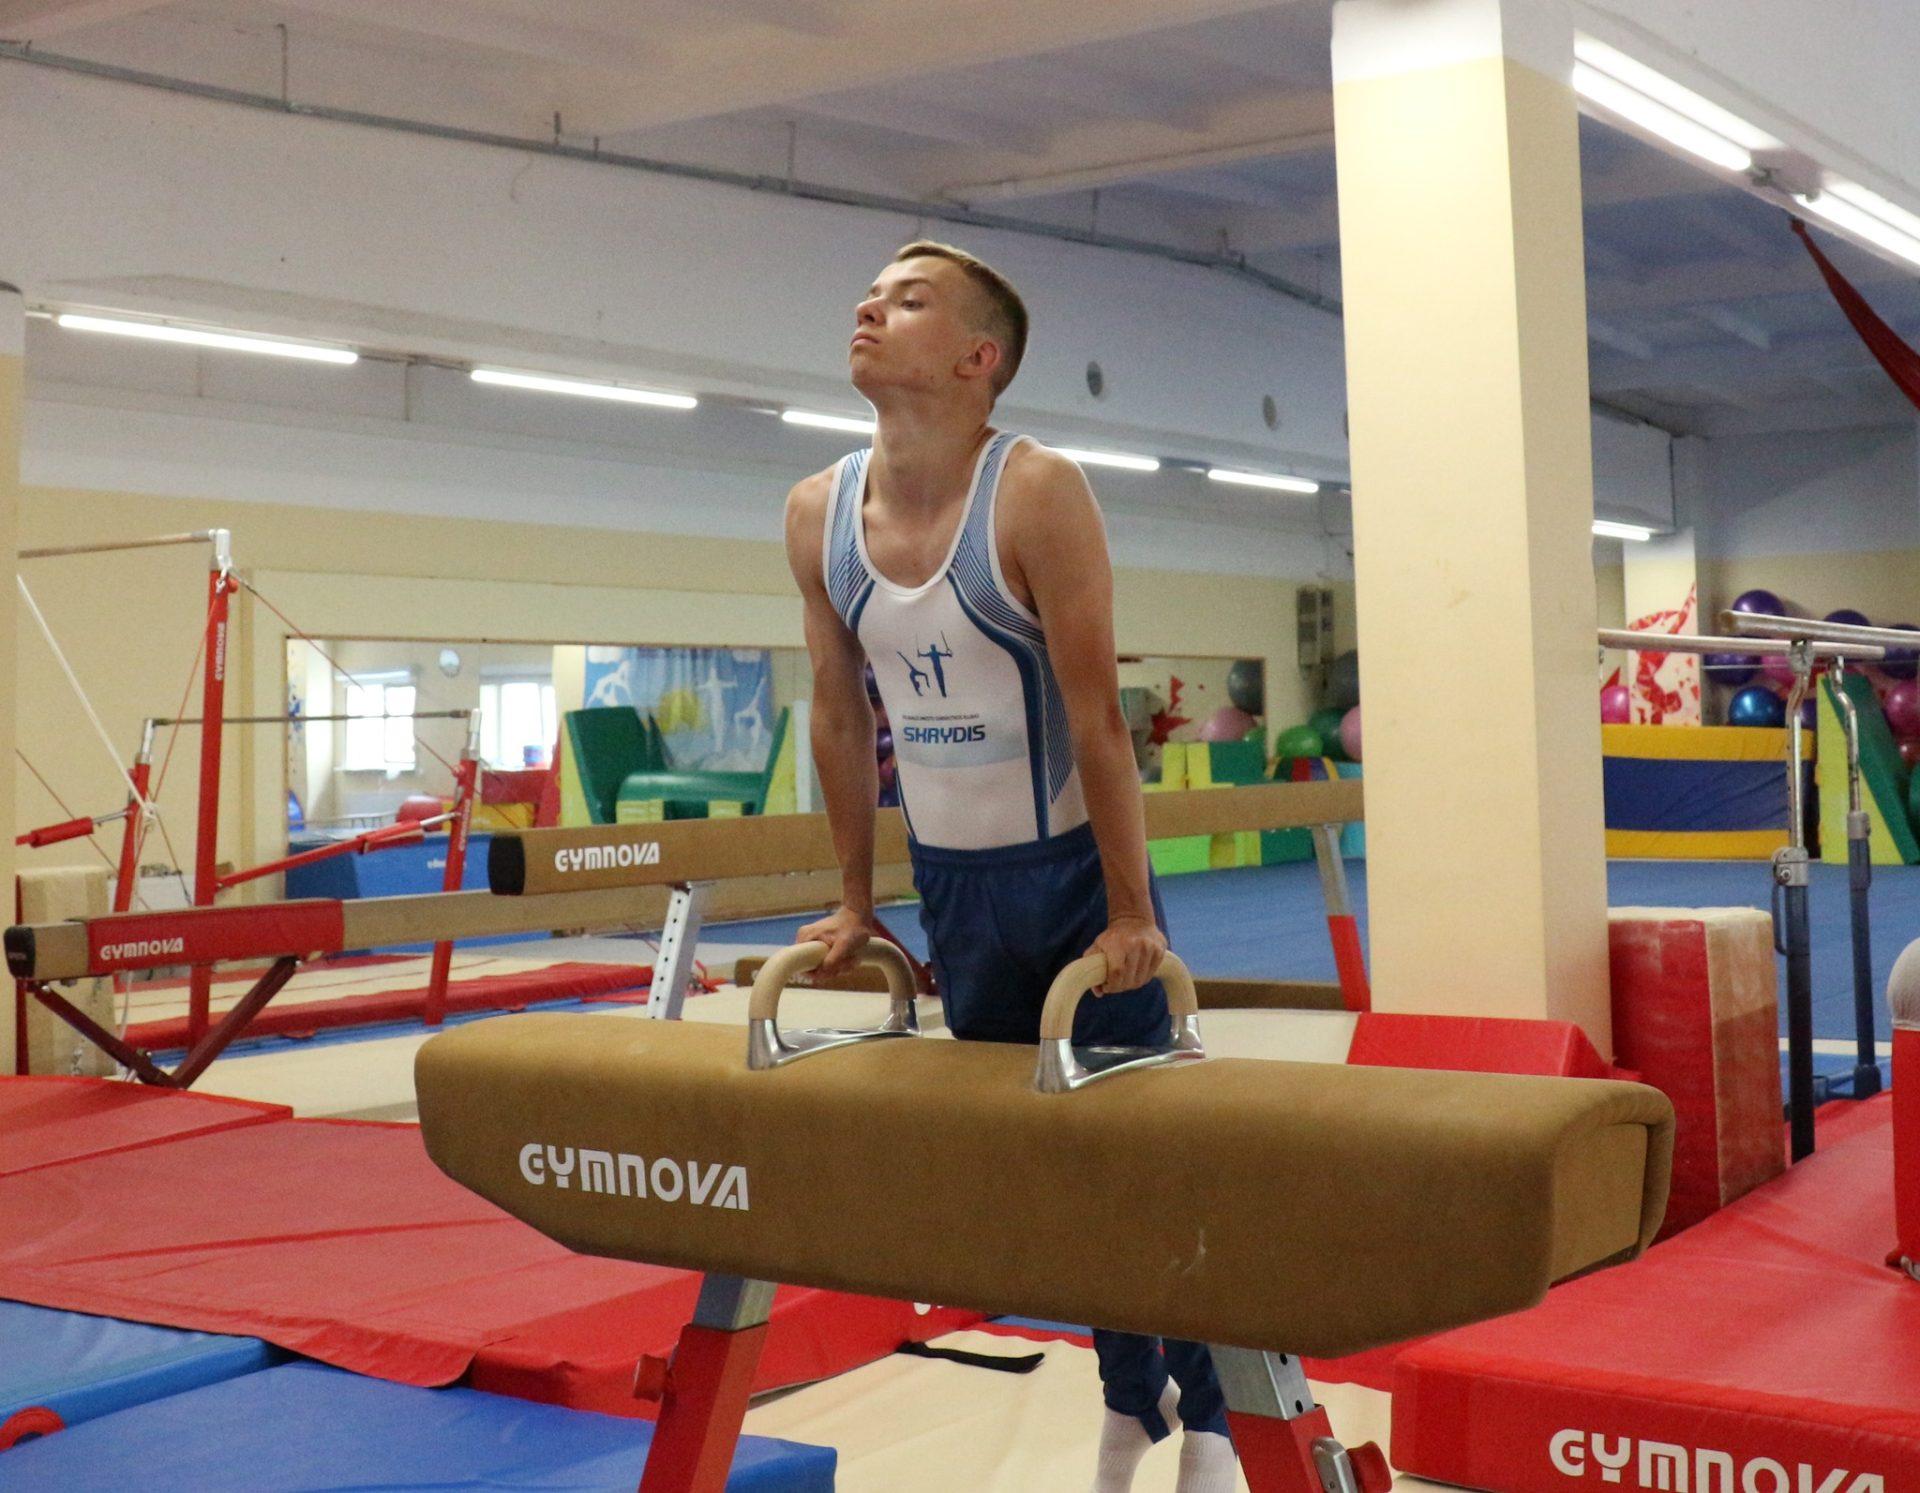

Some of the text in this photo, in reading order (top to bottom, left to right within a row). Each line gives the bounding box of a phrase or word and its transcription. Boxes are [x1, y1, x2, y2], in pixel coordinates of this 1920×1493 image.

[554, 841, 660, 873] GYMNOVA
[99, 936, 185, 961] GYMNOVA
[519, 1142, 749, 1211] GYMNOVA
